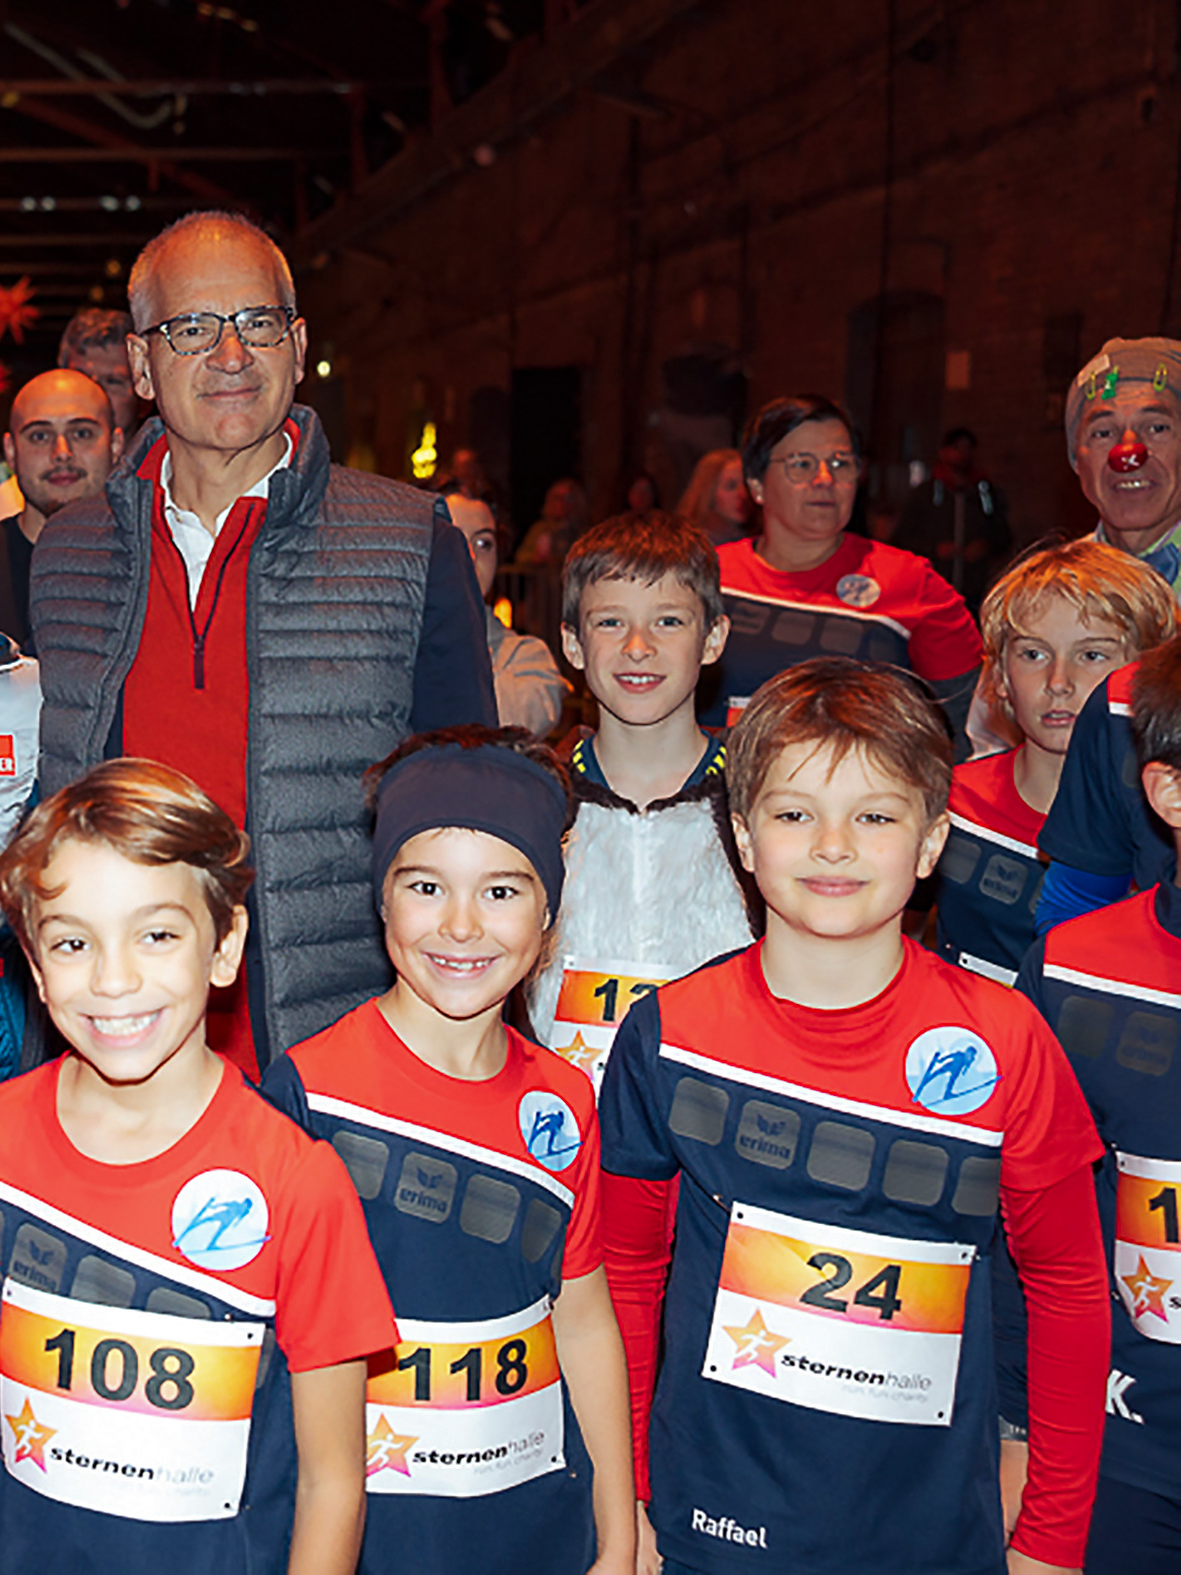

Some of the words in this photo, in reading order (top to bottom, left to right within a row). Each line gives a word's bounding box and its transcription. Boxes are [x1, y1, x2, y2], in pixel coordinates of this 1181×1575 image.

[738, 1134, 791, 1160] erima
[399, 1187, 448, 1214] erima
[798, 1251, 903, 1321] 24
[43, 1327, 196, 1411] 108
[397, 1337, 529, 1402] 118
[780, 1353, 932, 1391] sternenhalle
[49, 1447, 215, 1485] sternenhalle
[412, 1432, 545, 1465] sternenhalle
[691, 1507, 768, 1549] Raffael
